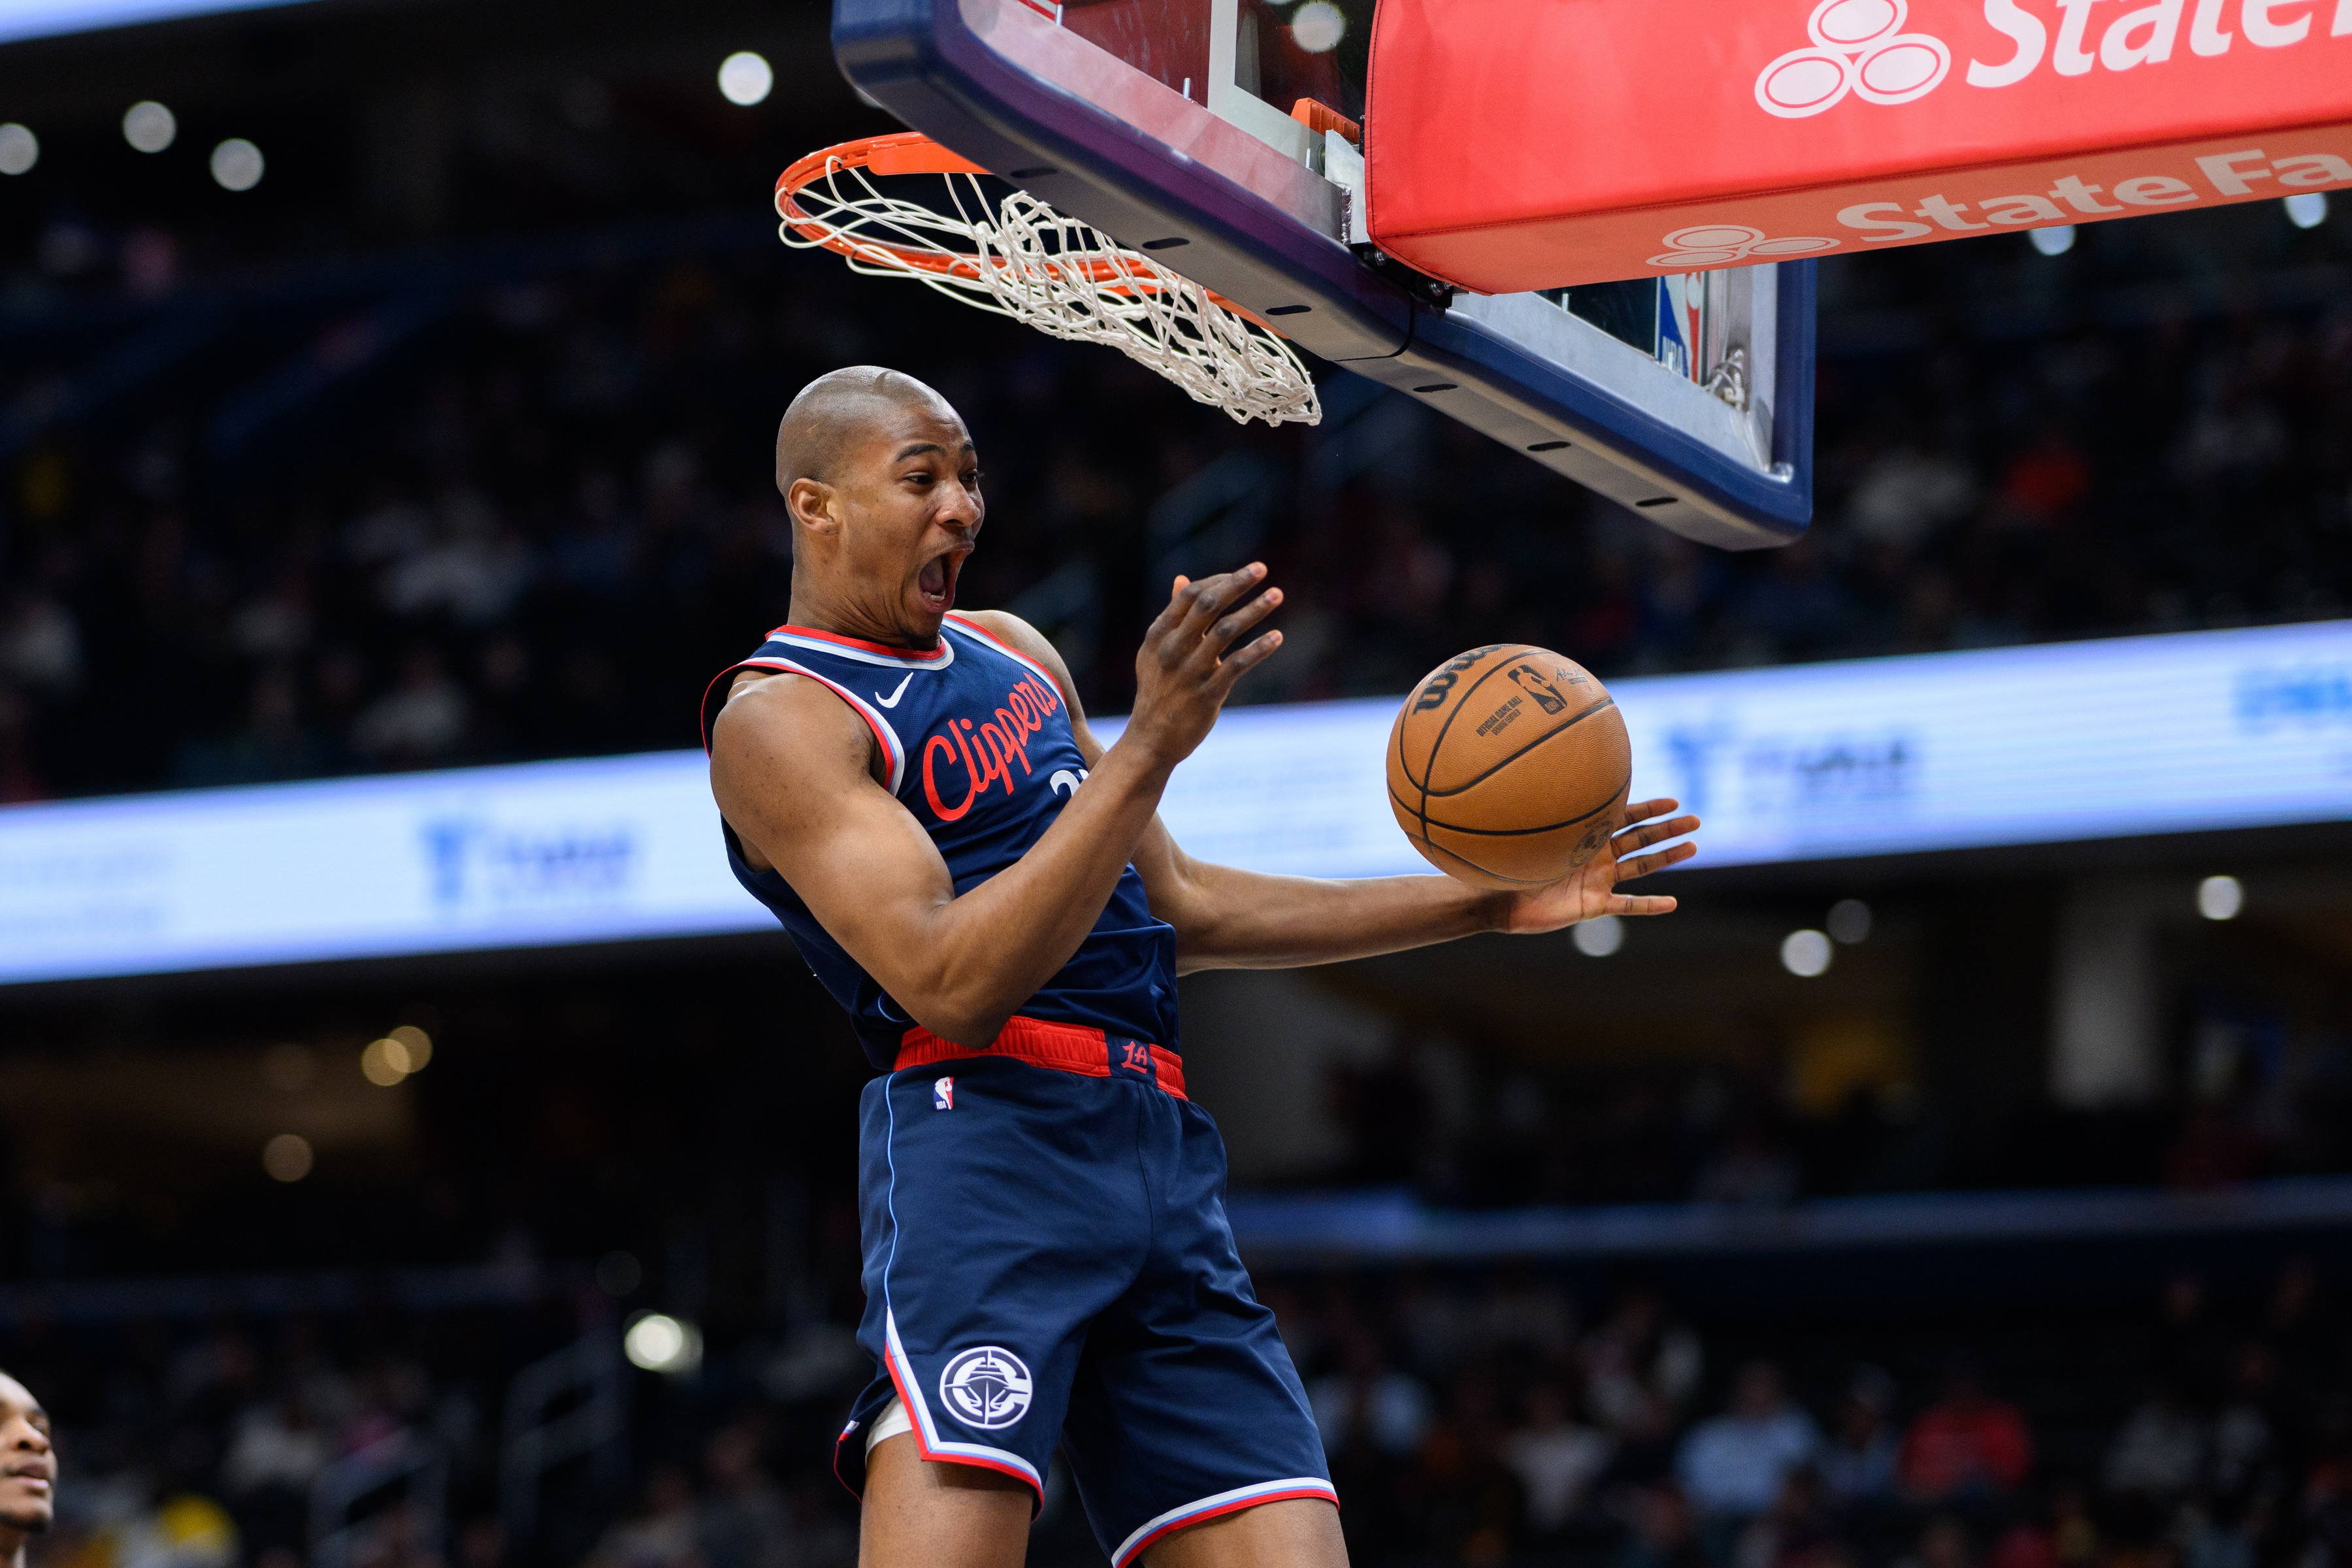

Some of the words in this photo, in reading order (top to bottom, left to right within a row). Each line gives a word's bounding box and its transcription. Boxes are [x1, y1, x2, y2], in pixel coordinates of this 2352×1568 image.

[1837, 174, 2200, 242] State
[1476, 715, 1499, 737] OFFICIAL
[1495, 704, 1512, 719] GAME
[1507, 696, 1524, 708] BALL
[923, 672, 1058, 821] Clippers
[1120, 1041, 1147, 1075] LA
[936, 1100, 947, 1110] NBA
